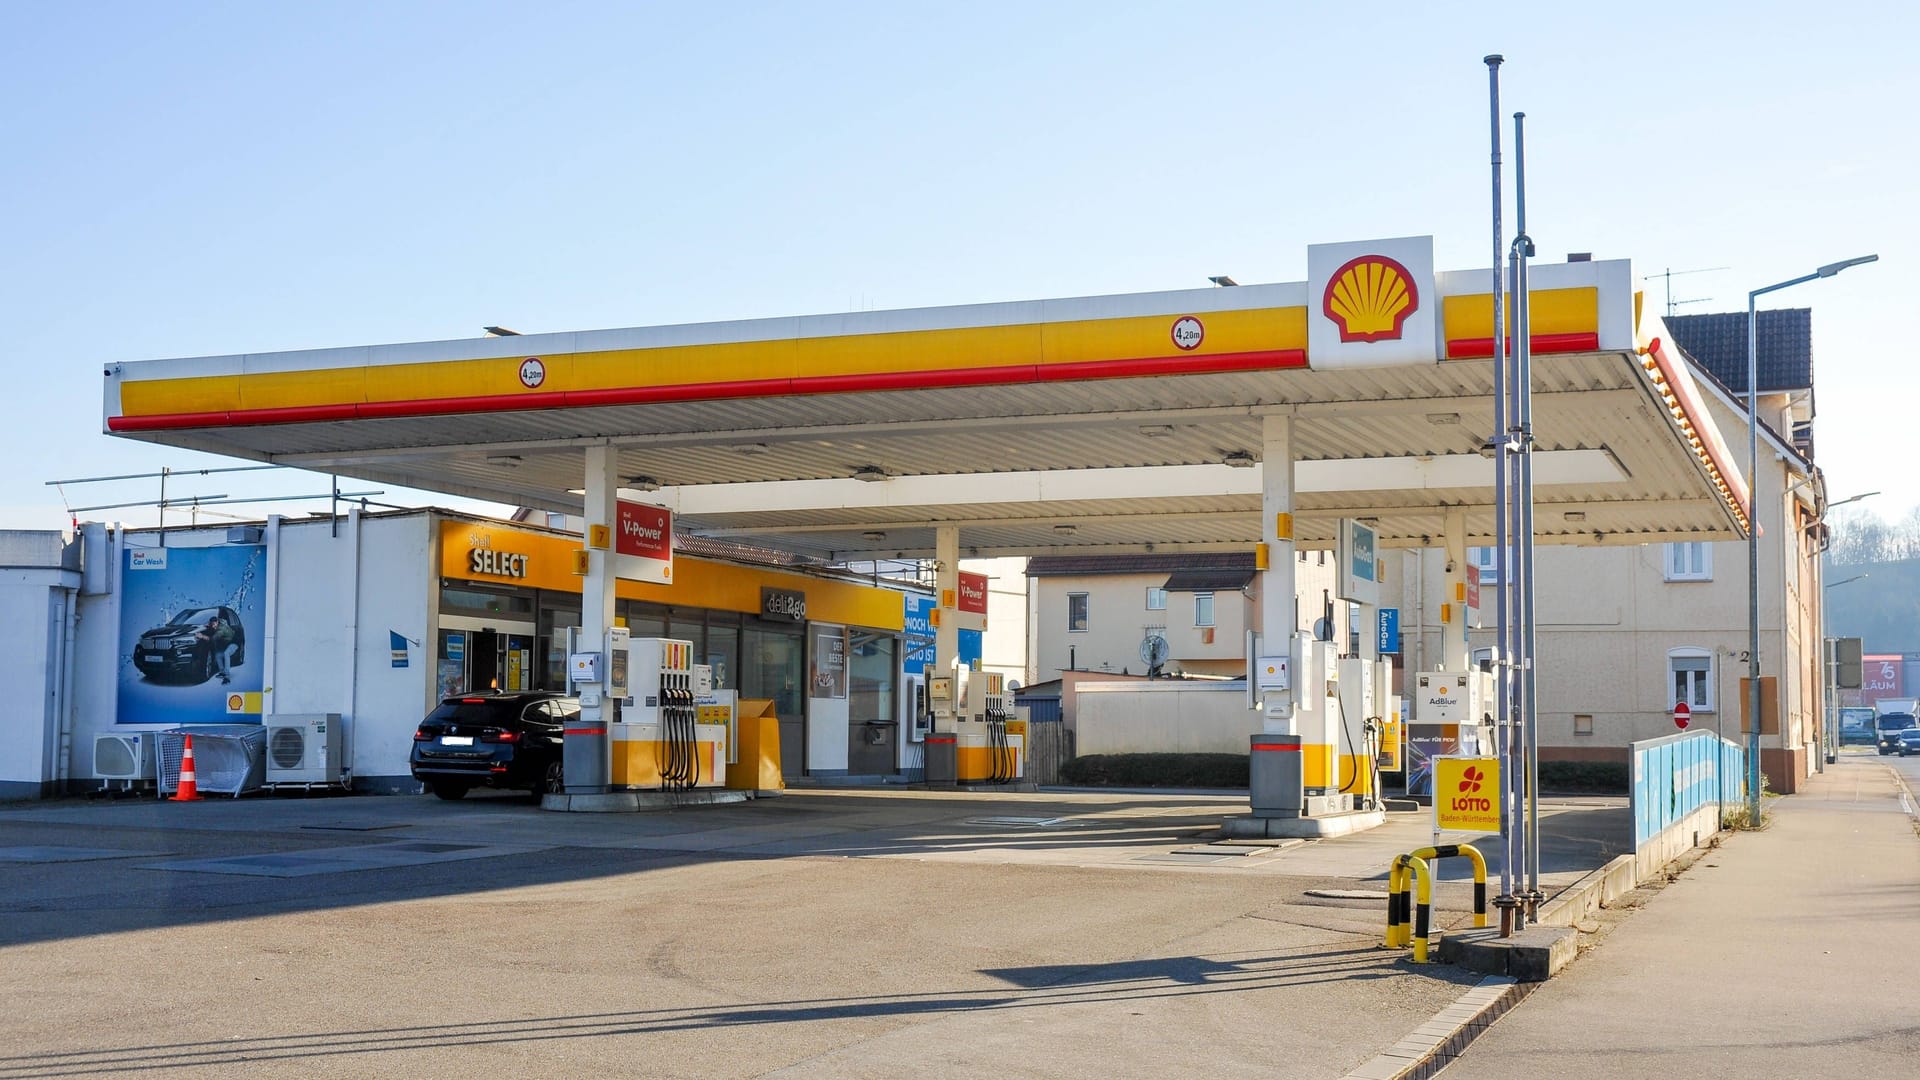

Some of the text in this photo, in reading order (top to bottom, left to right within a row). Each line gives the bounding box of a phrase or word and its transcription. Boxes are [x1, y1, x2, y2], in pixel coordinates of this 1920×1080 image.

[1176, 327, 1200, 341] 4,20m
[623, 520, 662, 541] V-Power
[470, 533, 491, 548] Shell
[145, 558, 164, 566] Wash
[473, 547, 529, 578] SELECT
[768, 592, 806, 620] deli2go
[1381, 611, 1389, 648] AutoGas
[1880, 661, 1896, 680] 75
[1429, 697, 1457, 705] AdBlue
[1452, 797, 1491, 812] LOTTO
